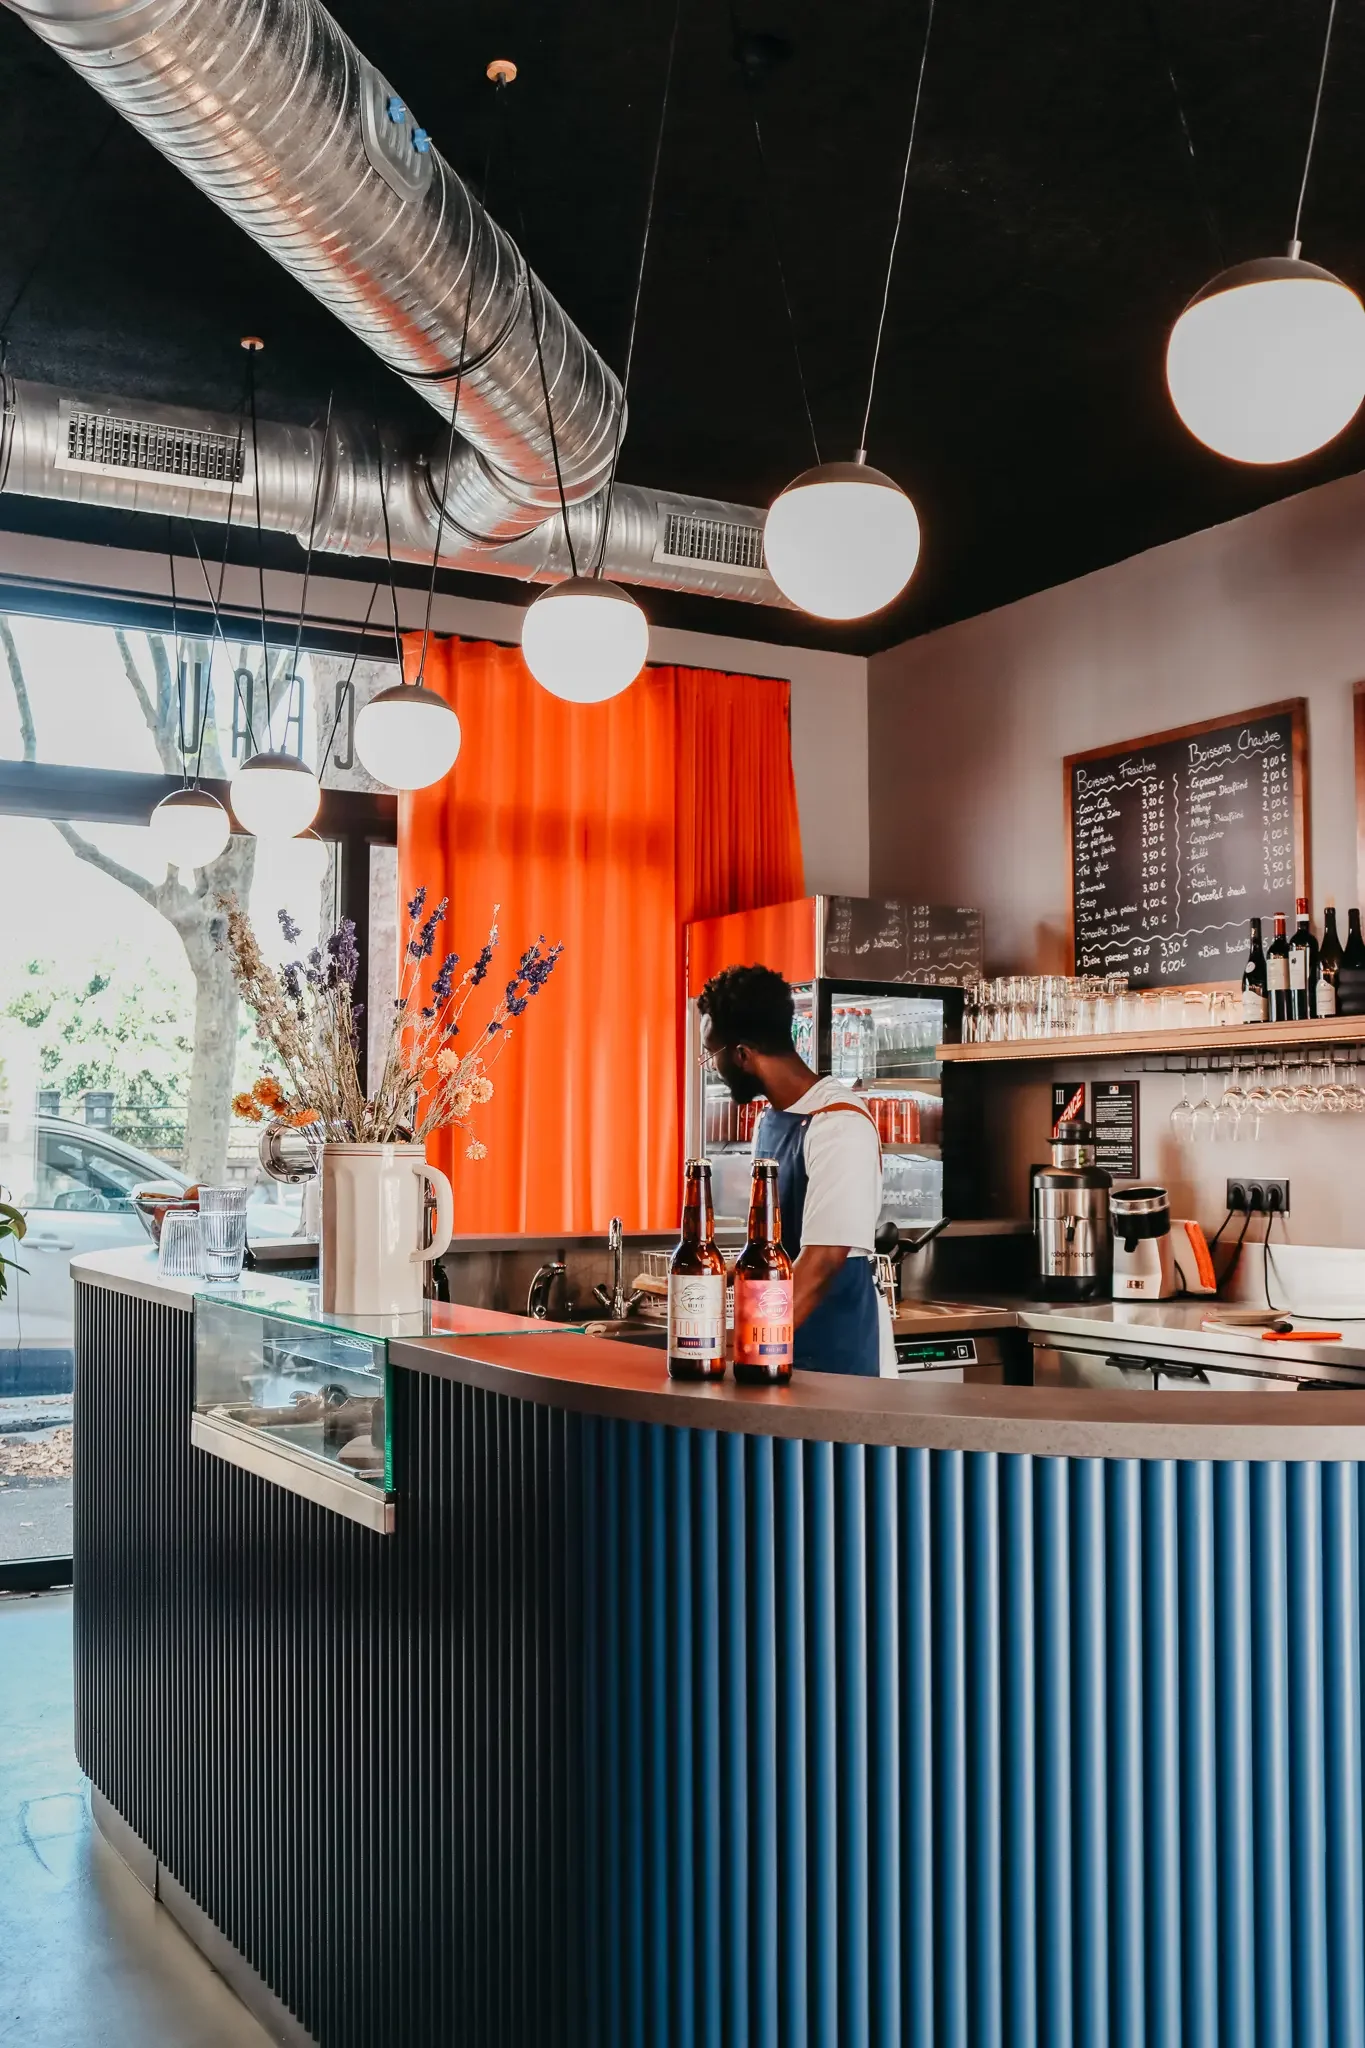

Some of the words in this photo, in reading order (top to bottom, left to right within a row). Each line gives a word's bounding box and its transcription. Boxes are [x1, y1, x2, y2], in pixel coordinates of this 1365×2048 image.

[1188, 743, 1231, 767] Boissons
[1238, 730, 1280, 750] Chaudes
[1262, 756, 1279, 770] 2,00
[1191, 774, 1224, 790] Expresso
[1142, 784, 1157, 796] 3,20
[1080, 798, 1111, 814] Coca-Cola
[1142, 798, 1156, 809] 3,20
[1080, 812, 1105, 826] Coca-Cola
[1142, 812, 1157, 824] 3,20
[1263, 812, 1281, 826] 3,50
[1142, 824, 1158, 835] 3,20
[1142, 836, 1158, 848] 3,00
[1263, 830, 1282, 844] 4,00
[1142, 851, 1158, 863] 3,50
[1263, 846, 1283, 861] 3,50
[1079, 865, 1090, 876] Thé
[1142, 866, 1158, 878] 2,50
[1190, 863, 1205, 874] Thé
[1264, 862, 1283, 876] 3,50
[1143, 882, 1158, 893] 3,20
[1263, 878, 1284, 893] 4,00
[1192, 887, 1223, 904] Chocolat
[1227, 885, 1246, 896] chaud
[1080, 899, 1096, 909] Sirop
[1143, 899, 1159, 910] 4,00
[1142, 916, 1158, 930] 4,50
[1081, 927, 1108, 940] Smoothie
[1111, 924, 1130, 935] Detox
[1161, 942, 1180, 957] 3,50
[1226, 939, 1250, 953] bouteill
[1134, 966, 1141, 976] 50
[1160, 960, 1180, 974] 6,00
